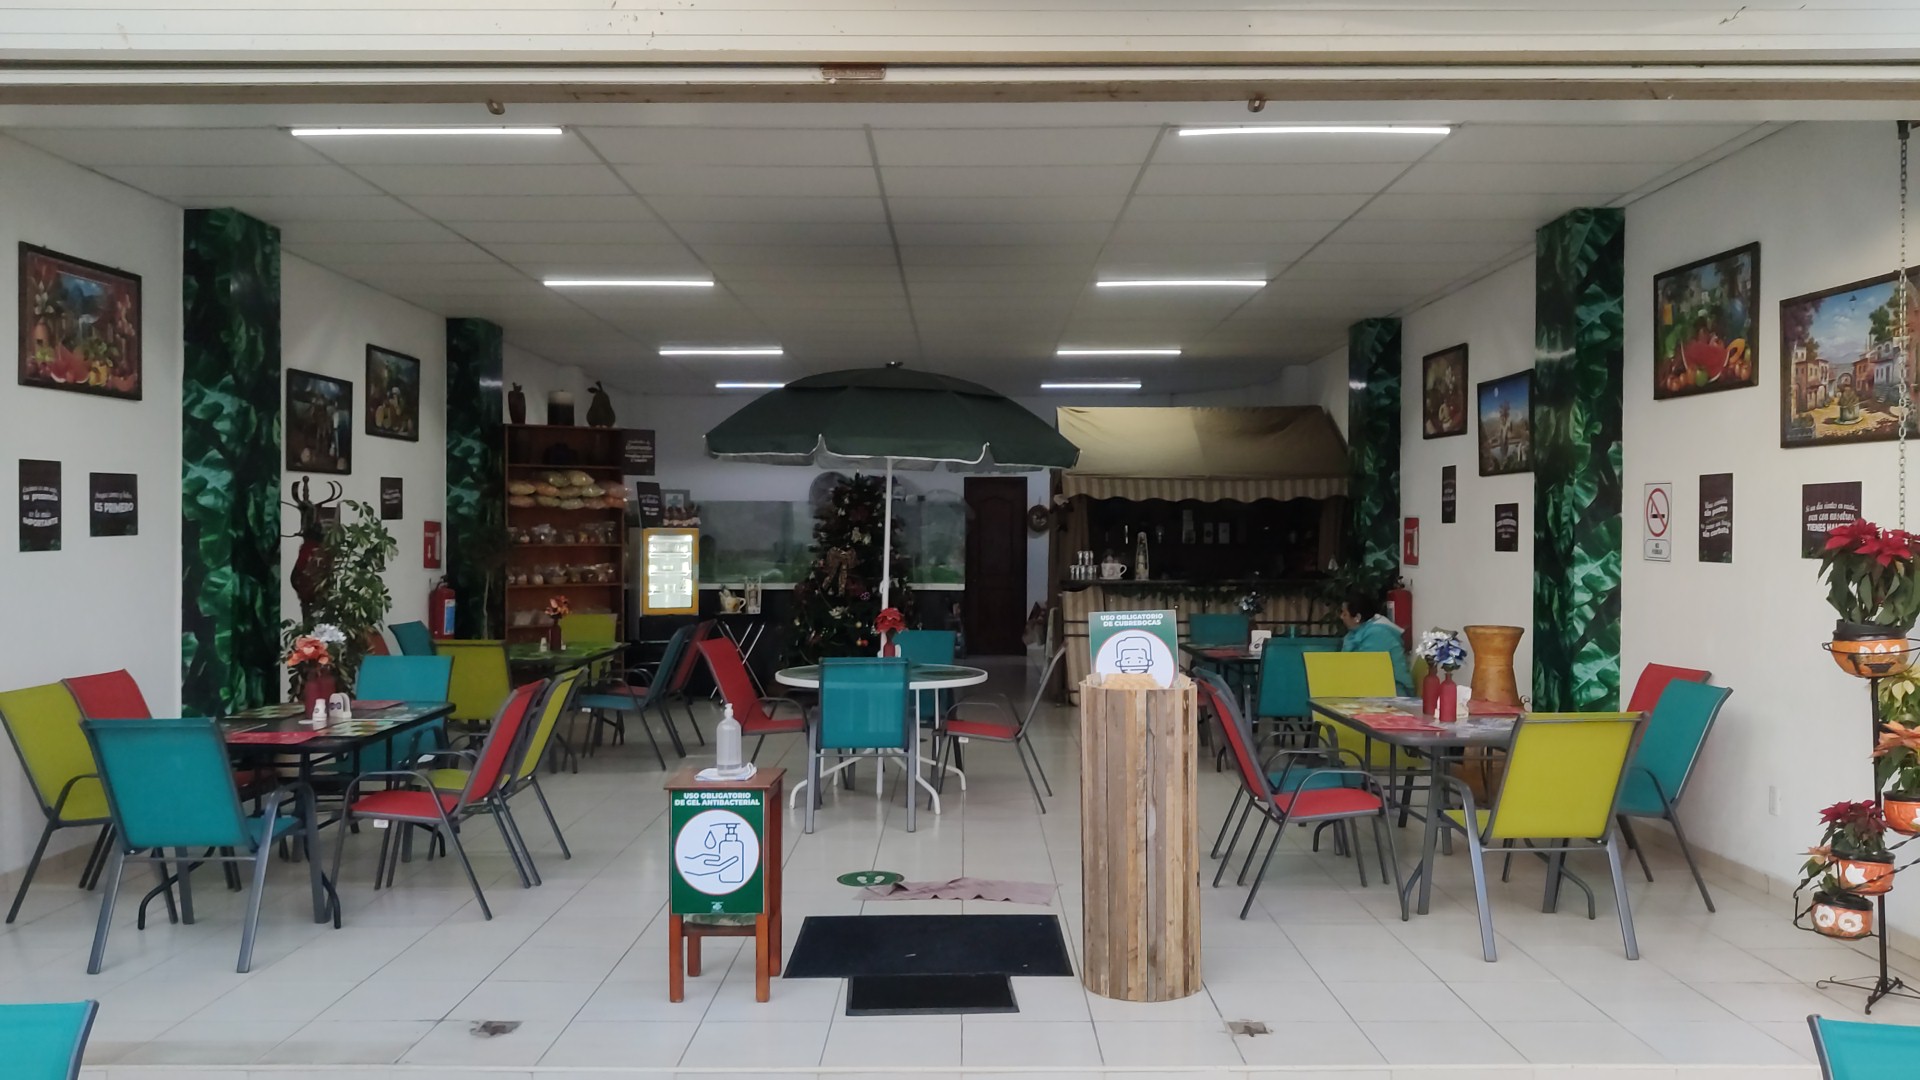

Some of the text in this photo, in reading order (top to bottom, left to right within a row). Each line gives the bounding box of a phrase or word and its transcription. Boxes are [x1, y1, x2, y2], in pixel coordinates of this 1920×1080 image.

[94, 502, 134, 514] ES PRIMERO
[1806, 523, 1826, 532] TIENES
